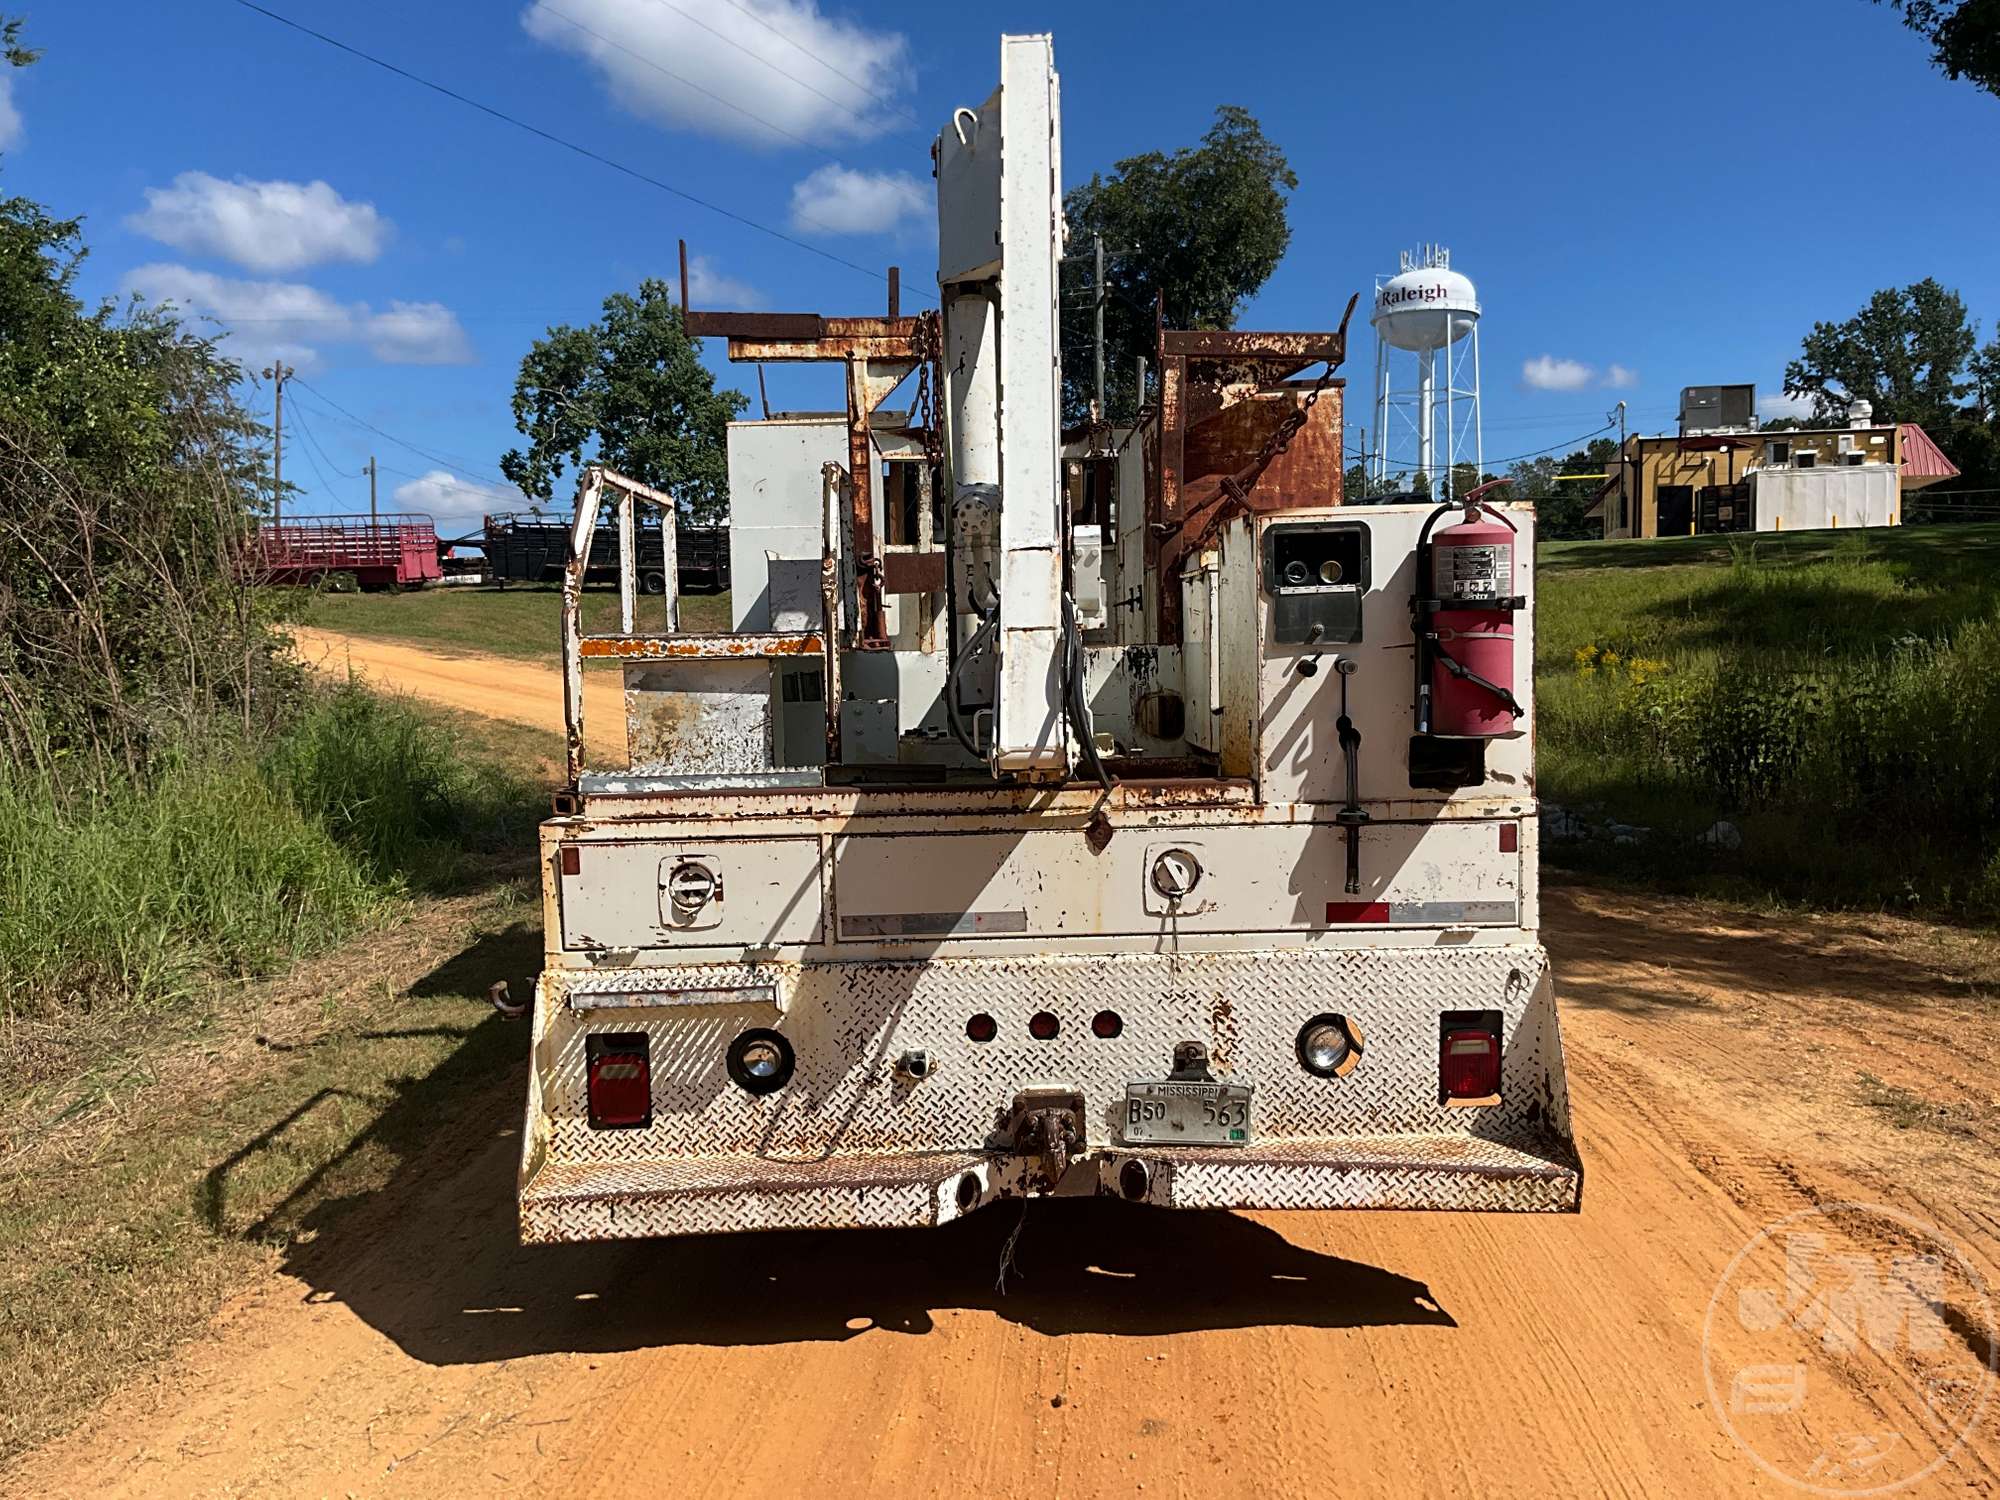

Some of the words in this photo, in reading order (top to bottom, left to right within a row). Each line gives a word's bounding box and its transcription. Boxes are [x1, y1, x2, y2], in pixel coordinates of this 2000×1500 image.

[1382, 284, 1448, 306] Raleigh
[1157, 1085, 1218, 1099] MISSISSIPPI
[1203, 1099, 1246, 1127] 563
